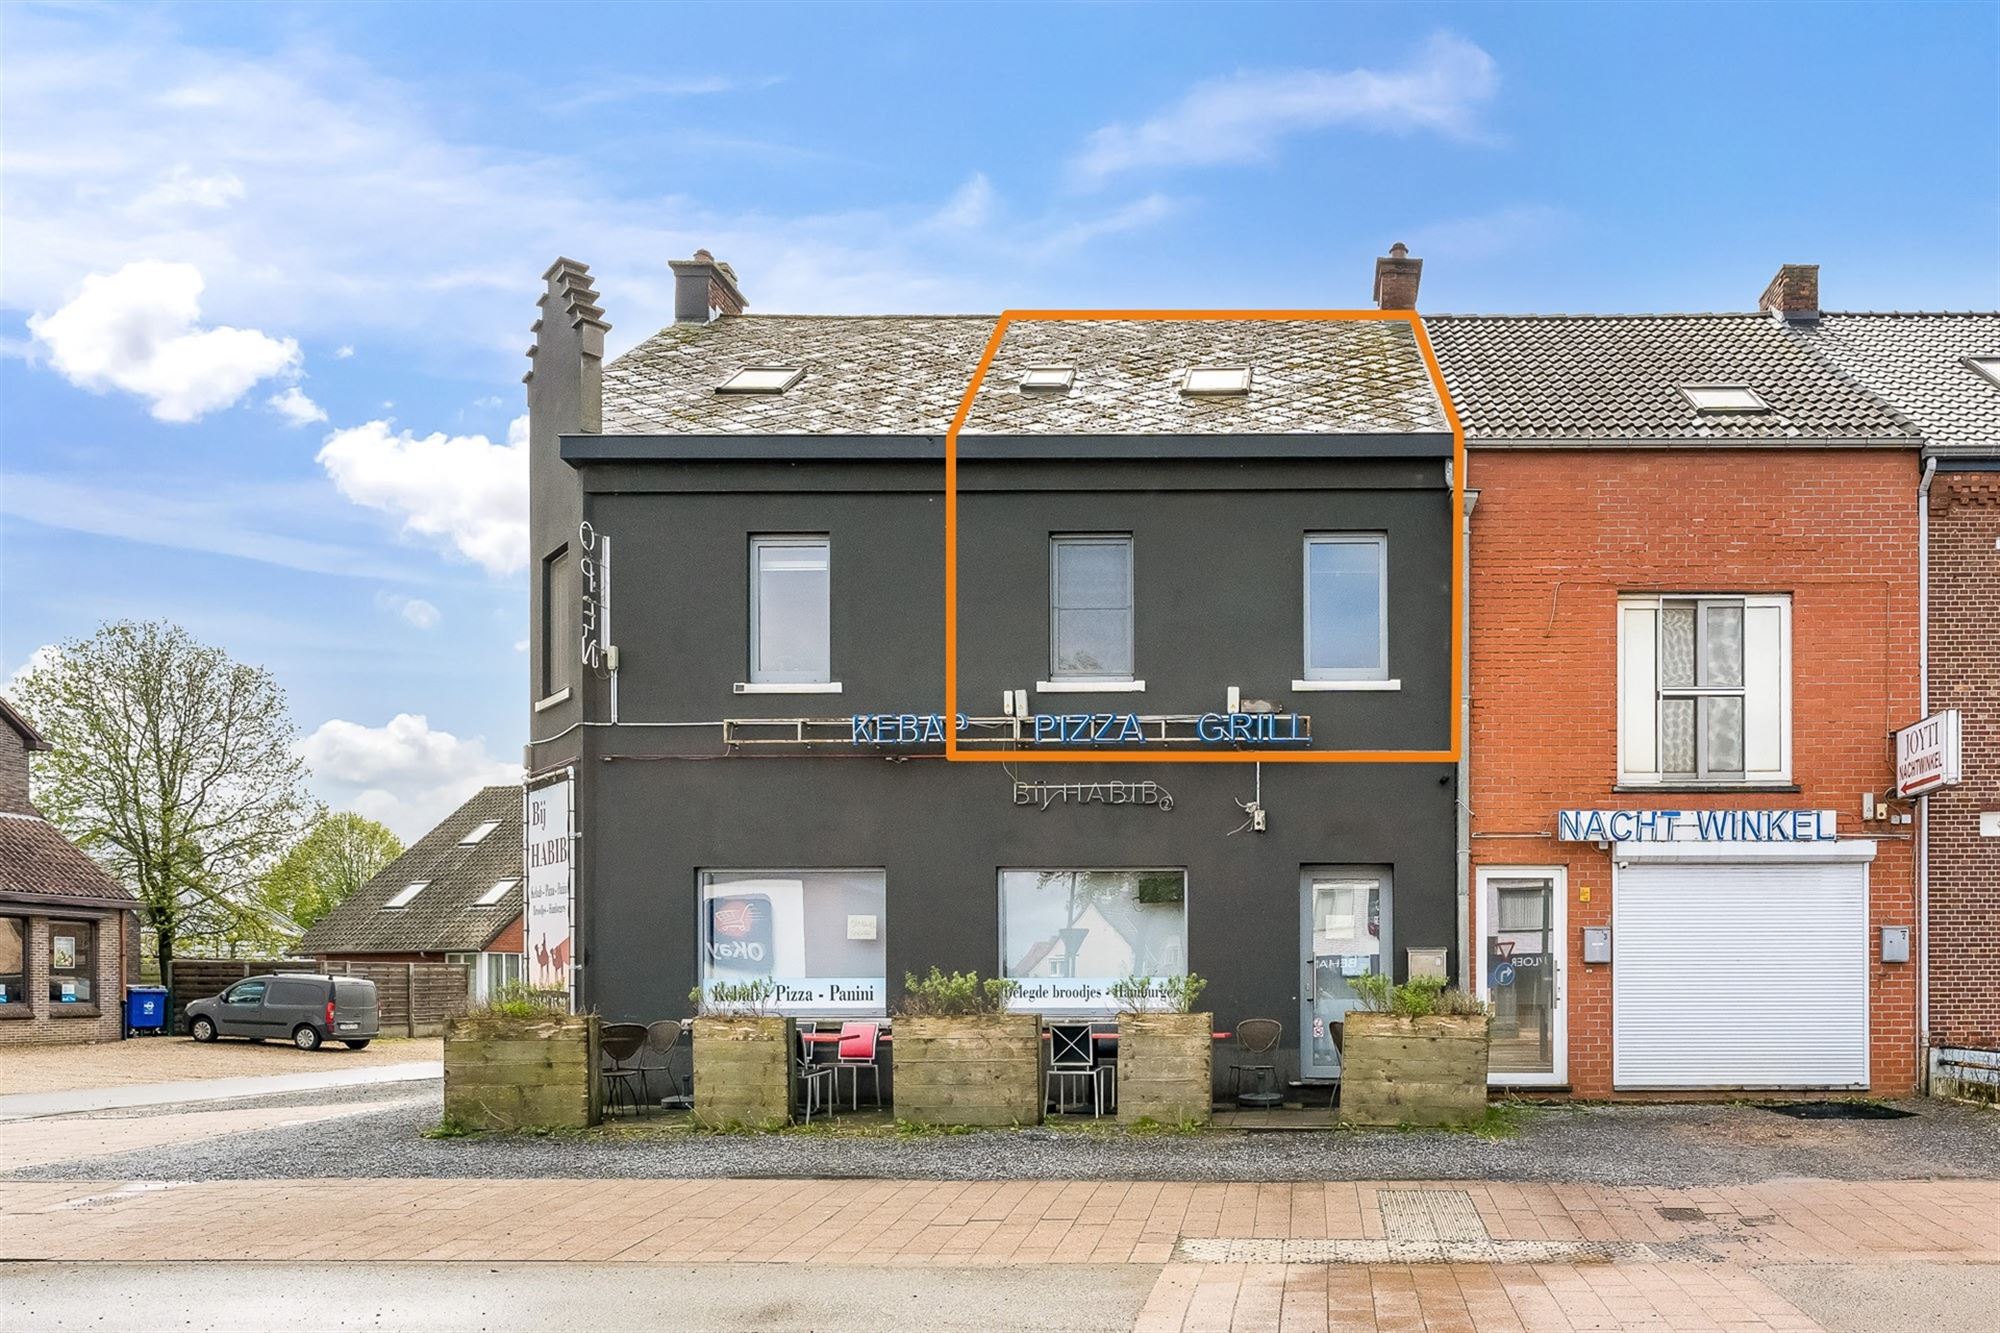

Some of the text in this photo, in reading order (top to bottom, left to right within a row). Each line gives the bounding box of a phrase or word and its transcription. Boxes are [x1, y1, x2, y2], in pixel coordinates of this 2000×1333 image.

[1034, 713, 1147, 744] PIZZA
[1196, 712, 1313, 744] GRILL
[1905, 722, 1939, 761] JOYTI
[1899, 751, 1943, 780] NACHTWINKEL
[532, 800, 546, 831] Bij
[1559, 810, 1837, 842] NACHT WINKEL
[531, 837, 567, 868] HABIB
[776, 984, 814, 1001] Pizza
[830, 984, 874, 1001] Panini
[1052, 984, 1102, 1002] broodjes
